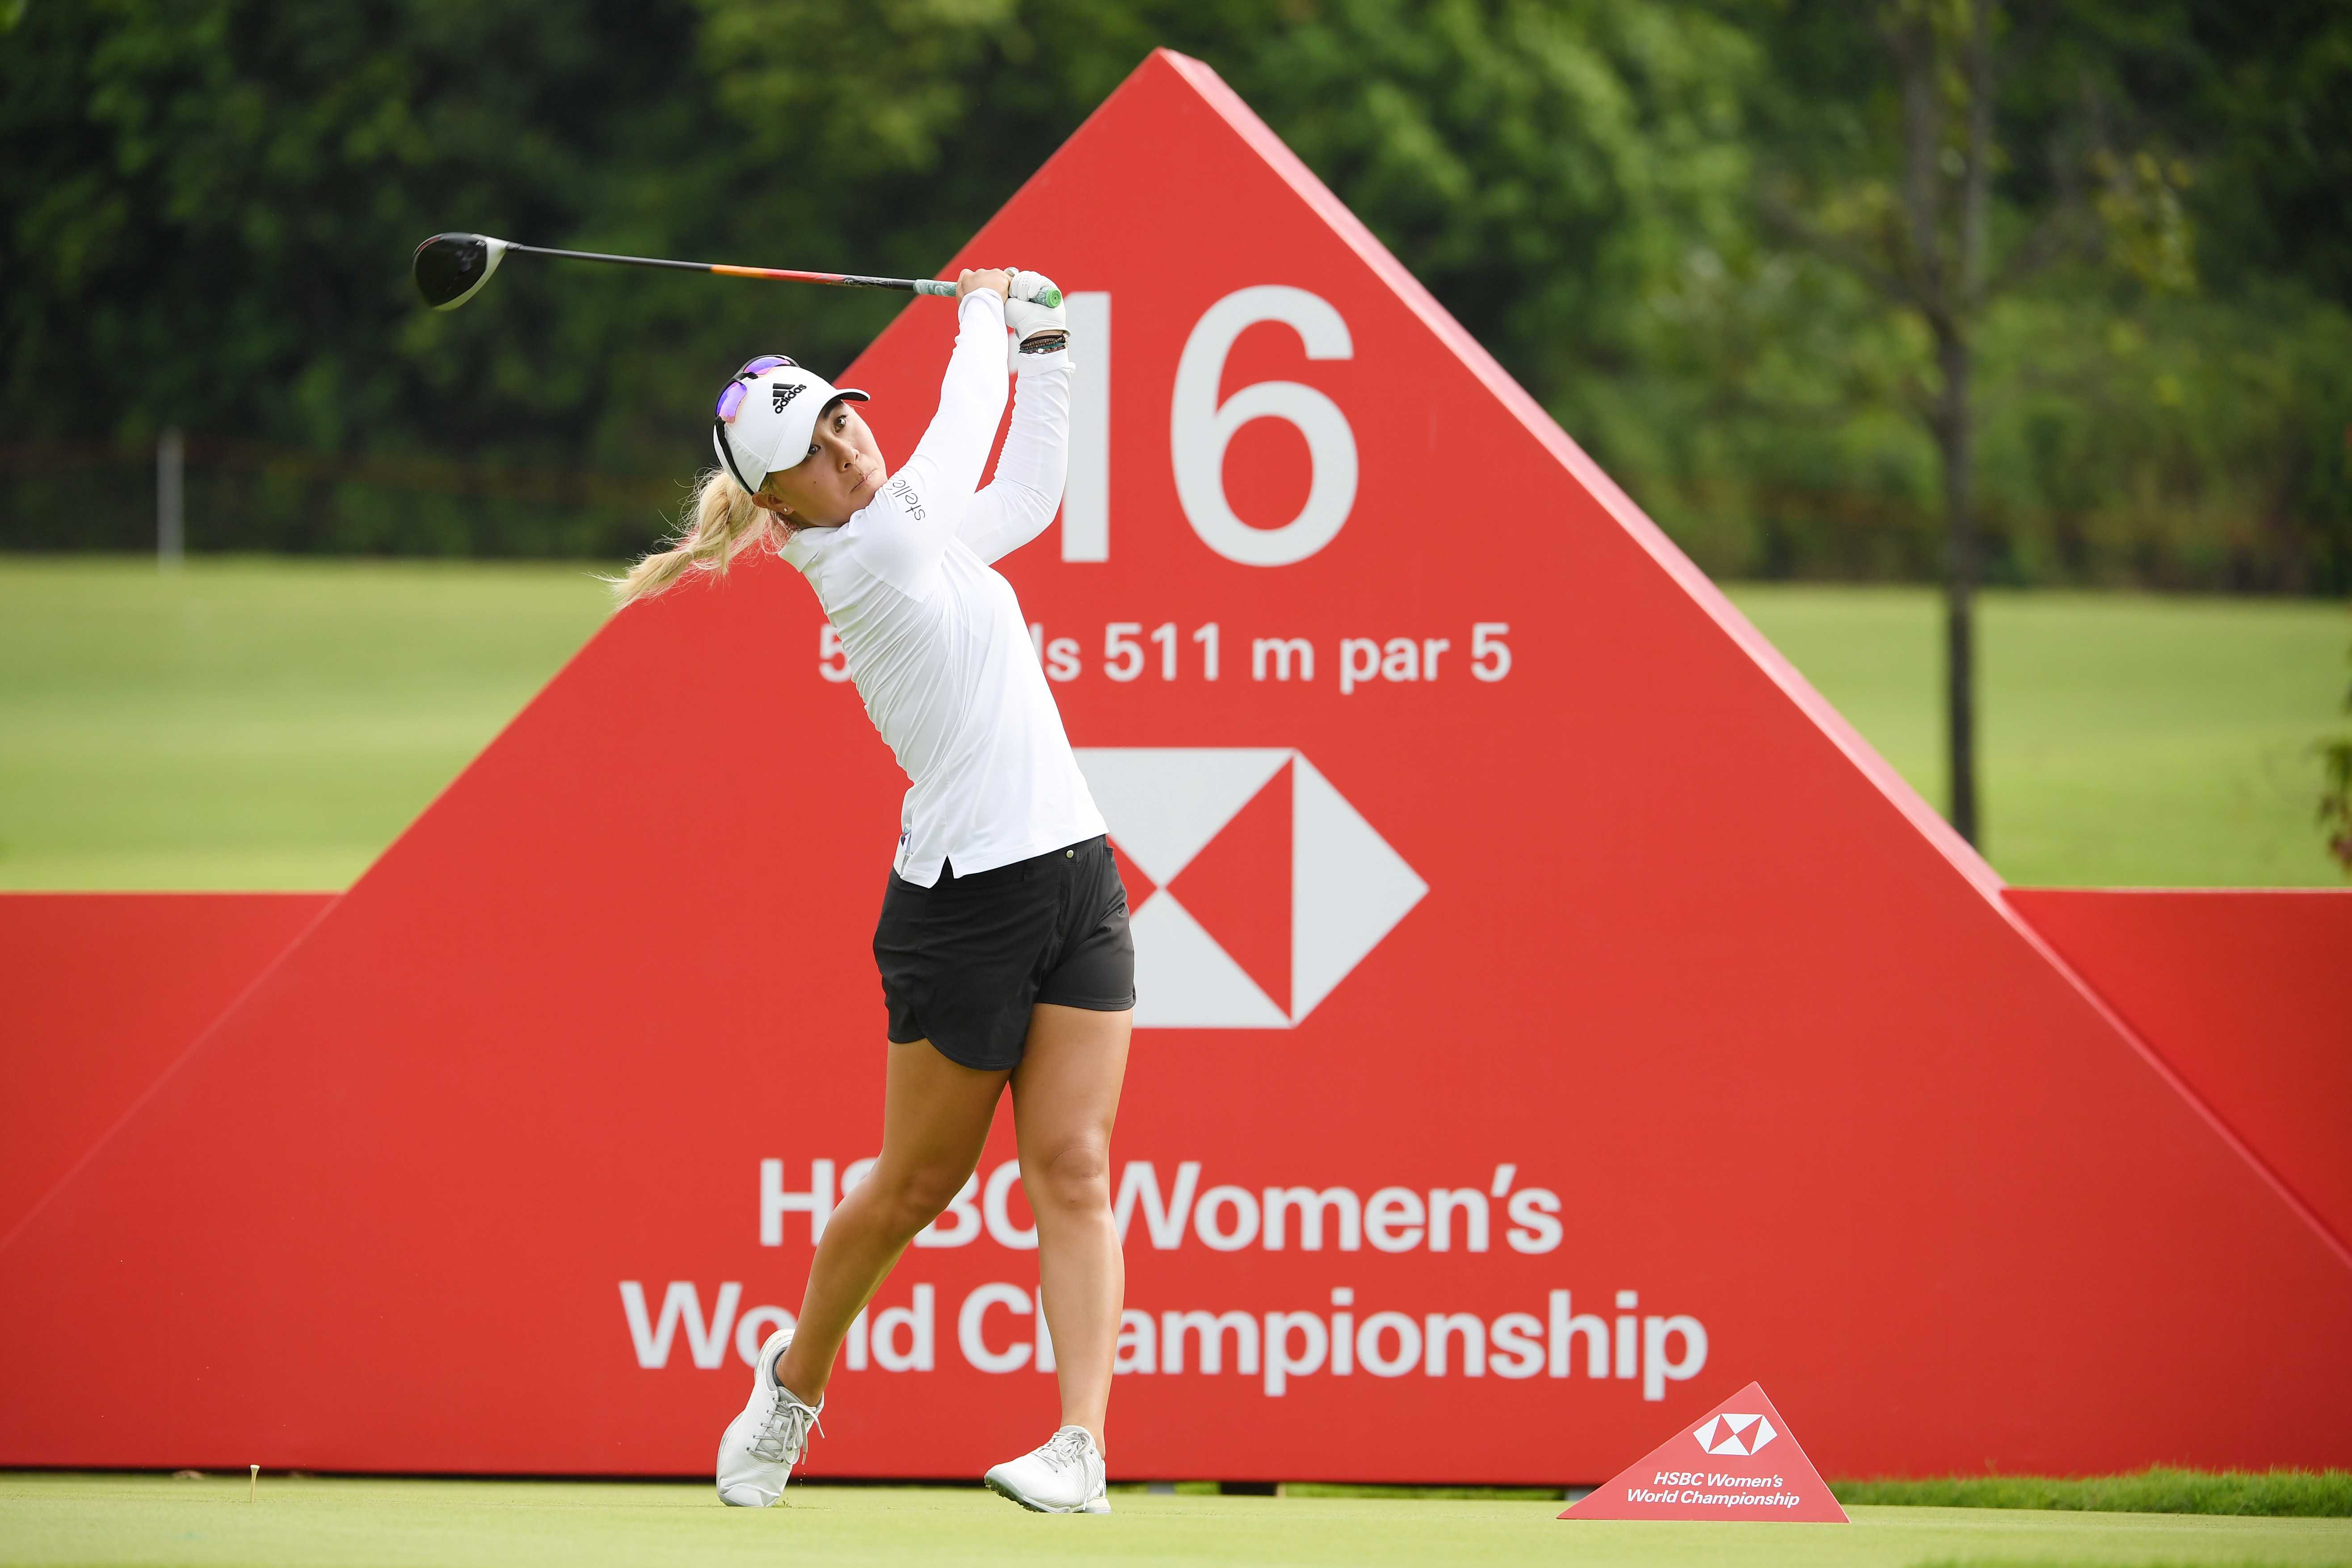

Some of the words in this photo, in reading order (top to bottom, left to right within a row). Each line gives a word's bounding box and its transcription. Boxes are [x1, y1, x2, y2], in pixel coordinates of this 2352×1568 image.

[774, 384, 807, 414] adidas
[1059, 284, 1359, 567] 16
[1104, 622, 1219, 683] 511
[1252, 636, 1314, 681] m
[1340, 636, 1450, 695] par
[1472, 622, 1512, 683] 5
[1111, 1160, 1563, 1255] Women's
[619, 1281, 935, 1372] Wold
[1627, 1488, 1679, 1503] World
[1680, 1490, 1801, 1509] Championship
[1654, 1471, 1705, 1486] HSBC
[1707, 1473, 1784, 1488] Women's
